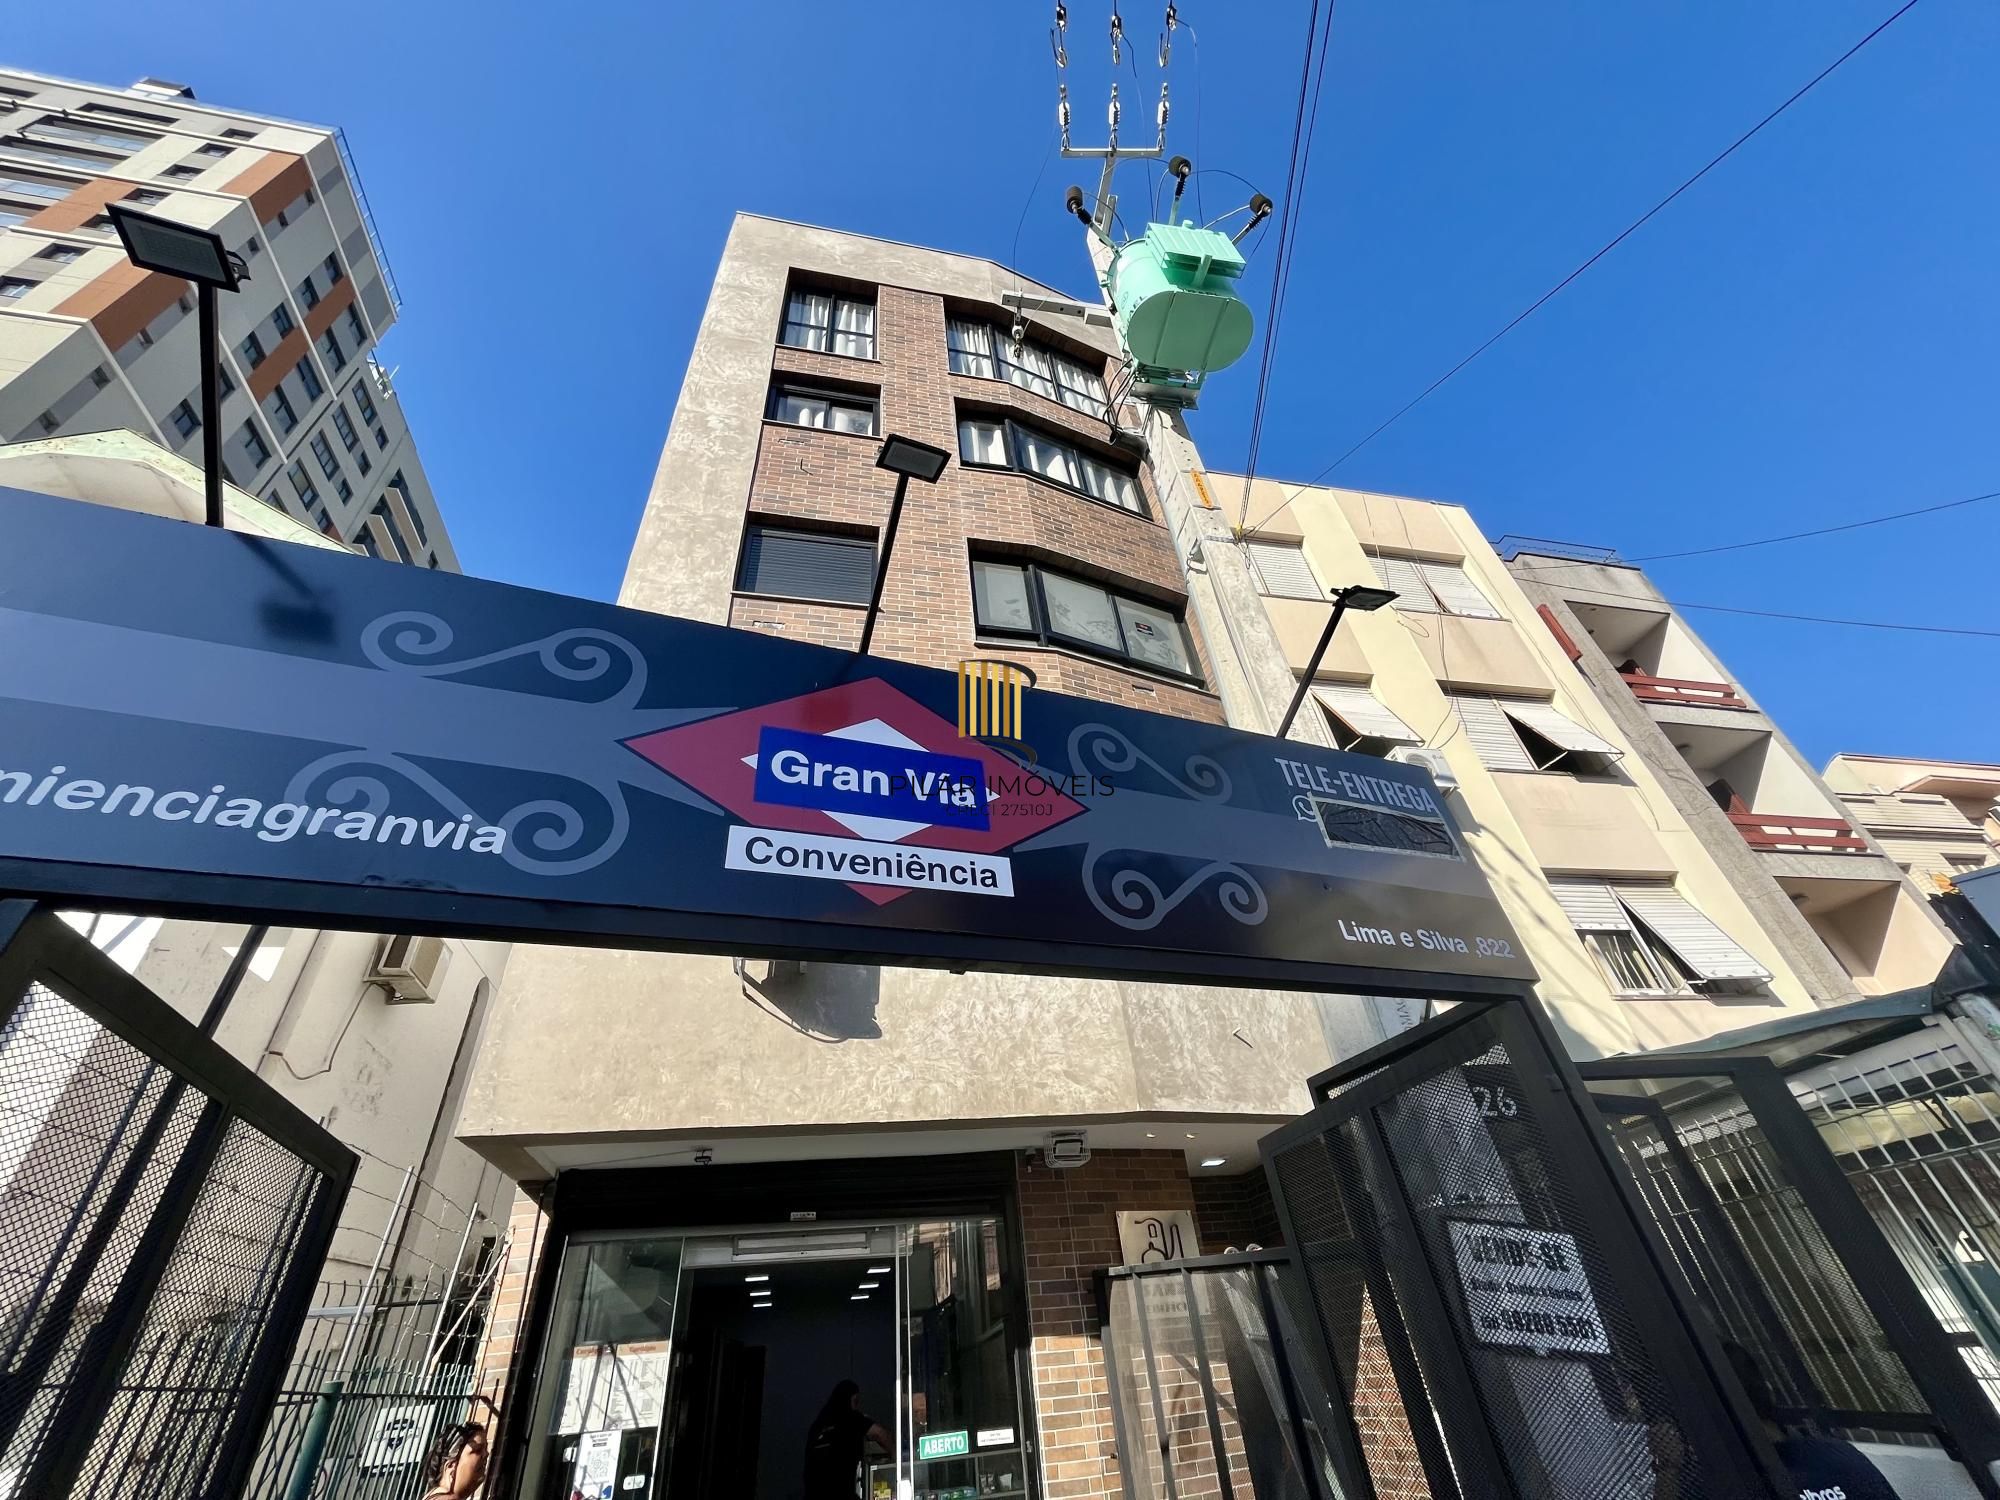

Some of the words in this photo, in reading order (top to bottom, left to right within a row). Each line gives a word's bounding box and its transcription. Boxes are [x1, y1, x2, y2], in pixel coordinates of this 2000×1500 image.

[771, 749, 890, 797] Gran
[904, 768, 977, 808] Vía
[1274, 758, 1440, 814] TELE-ENTREGA
[744, 836, 999, 888] Conveniência
[1337, 919, 1396, 947] Lima
[1401, 933, 1414, 948] e
[1416, 928, 1468, 954] Silva
[923, 1435, 965, 1457] ABERTO
